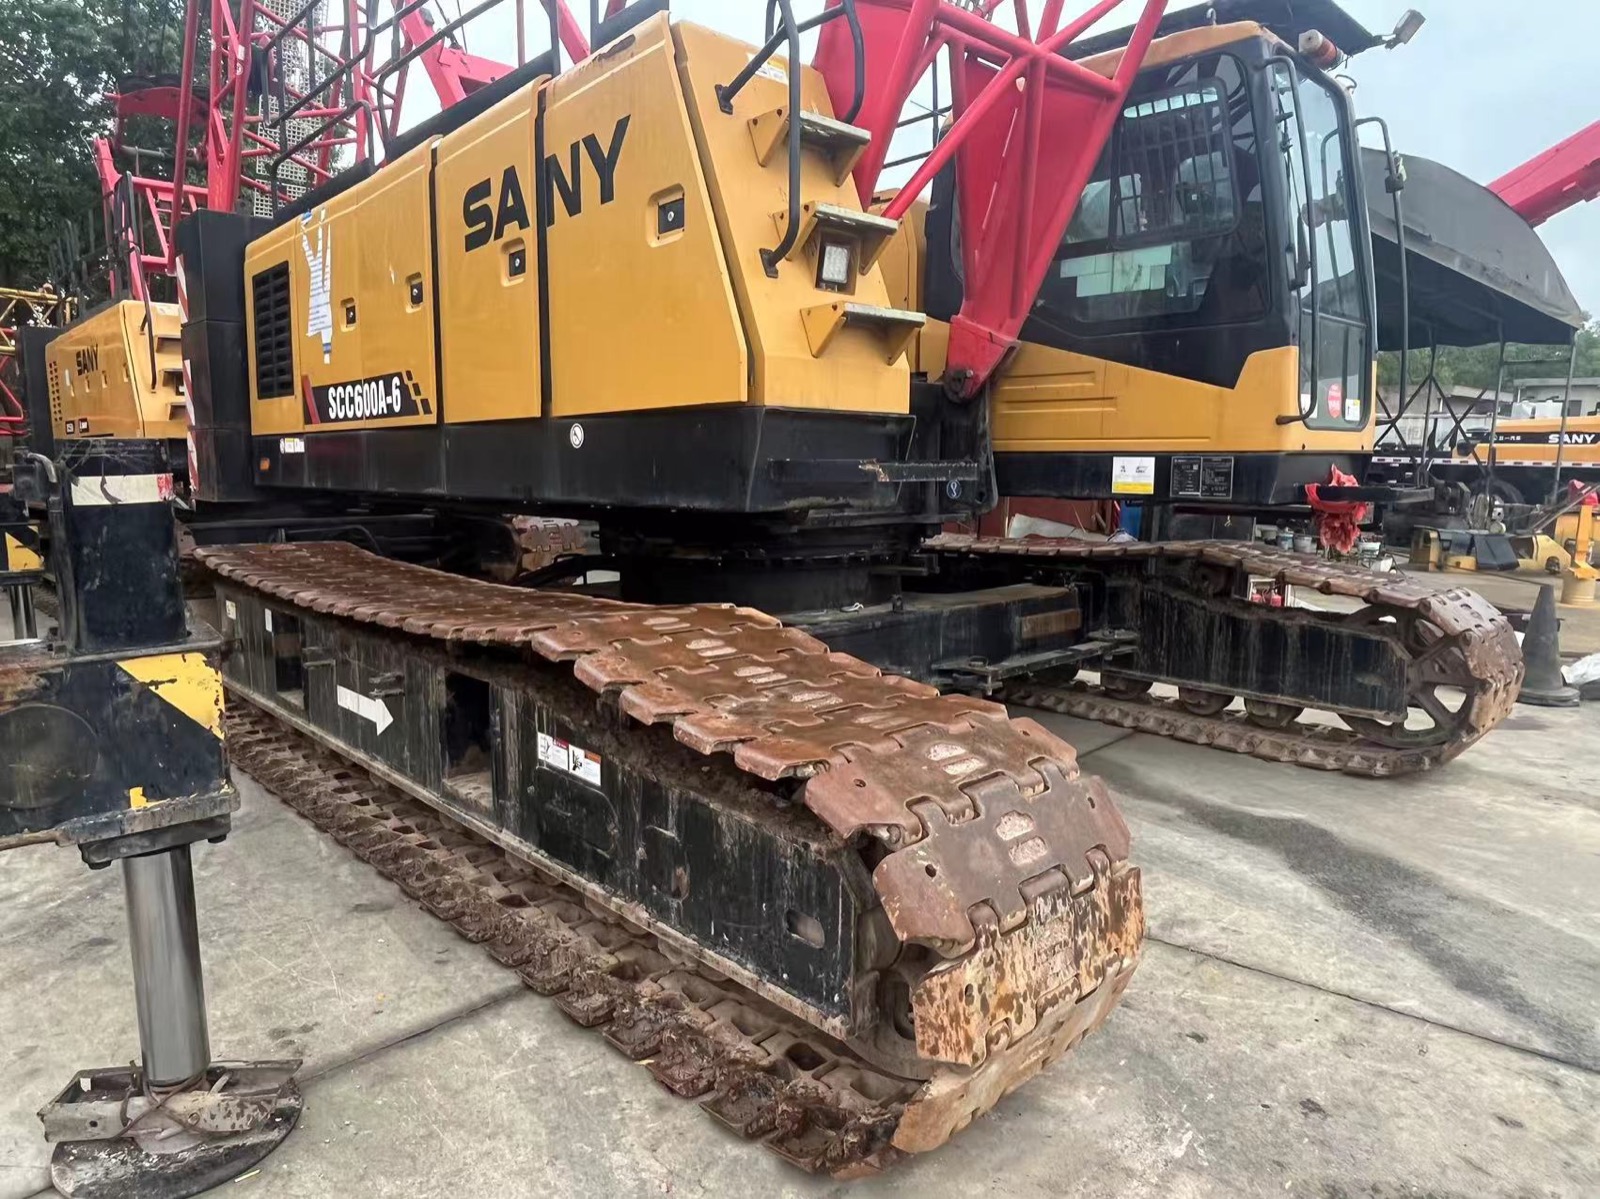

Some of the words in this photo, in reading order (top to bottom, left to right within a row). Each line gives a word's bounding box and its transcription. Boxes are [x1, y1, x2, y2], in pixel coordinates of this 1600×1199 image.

[463, 114, 631, 252] SANY
[76, 344, 99, 376] SANY
[328, 376, 402, 420] SCC600A-6
[1548, 433, 1596, 444] SANY
